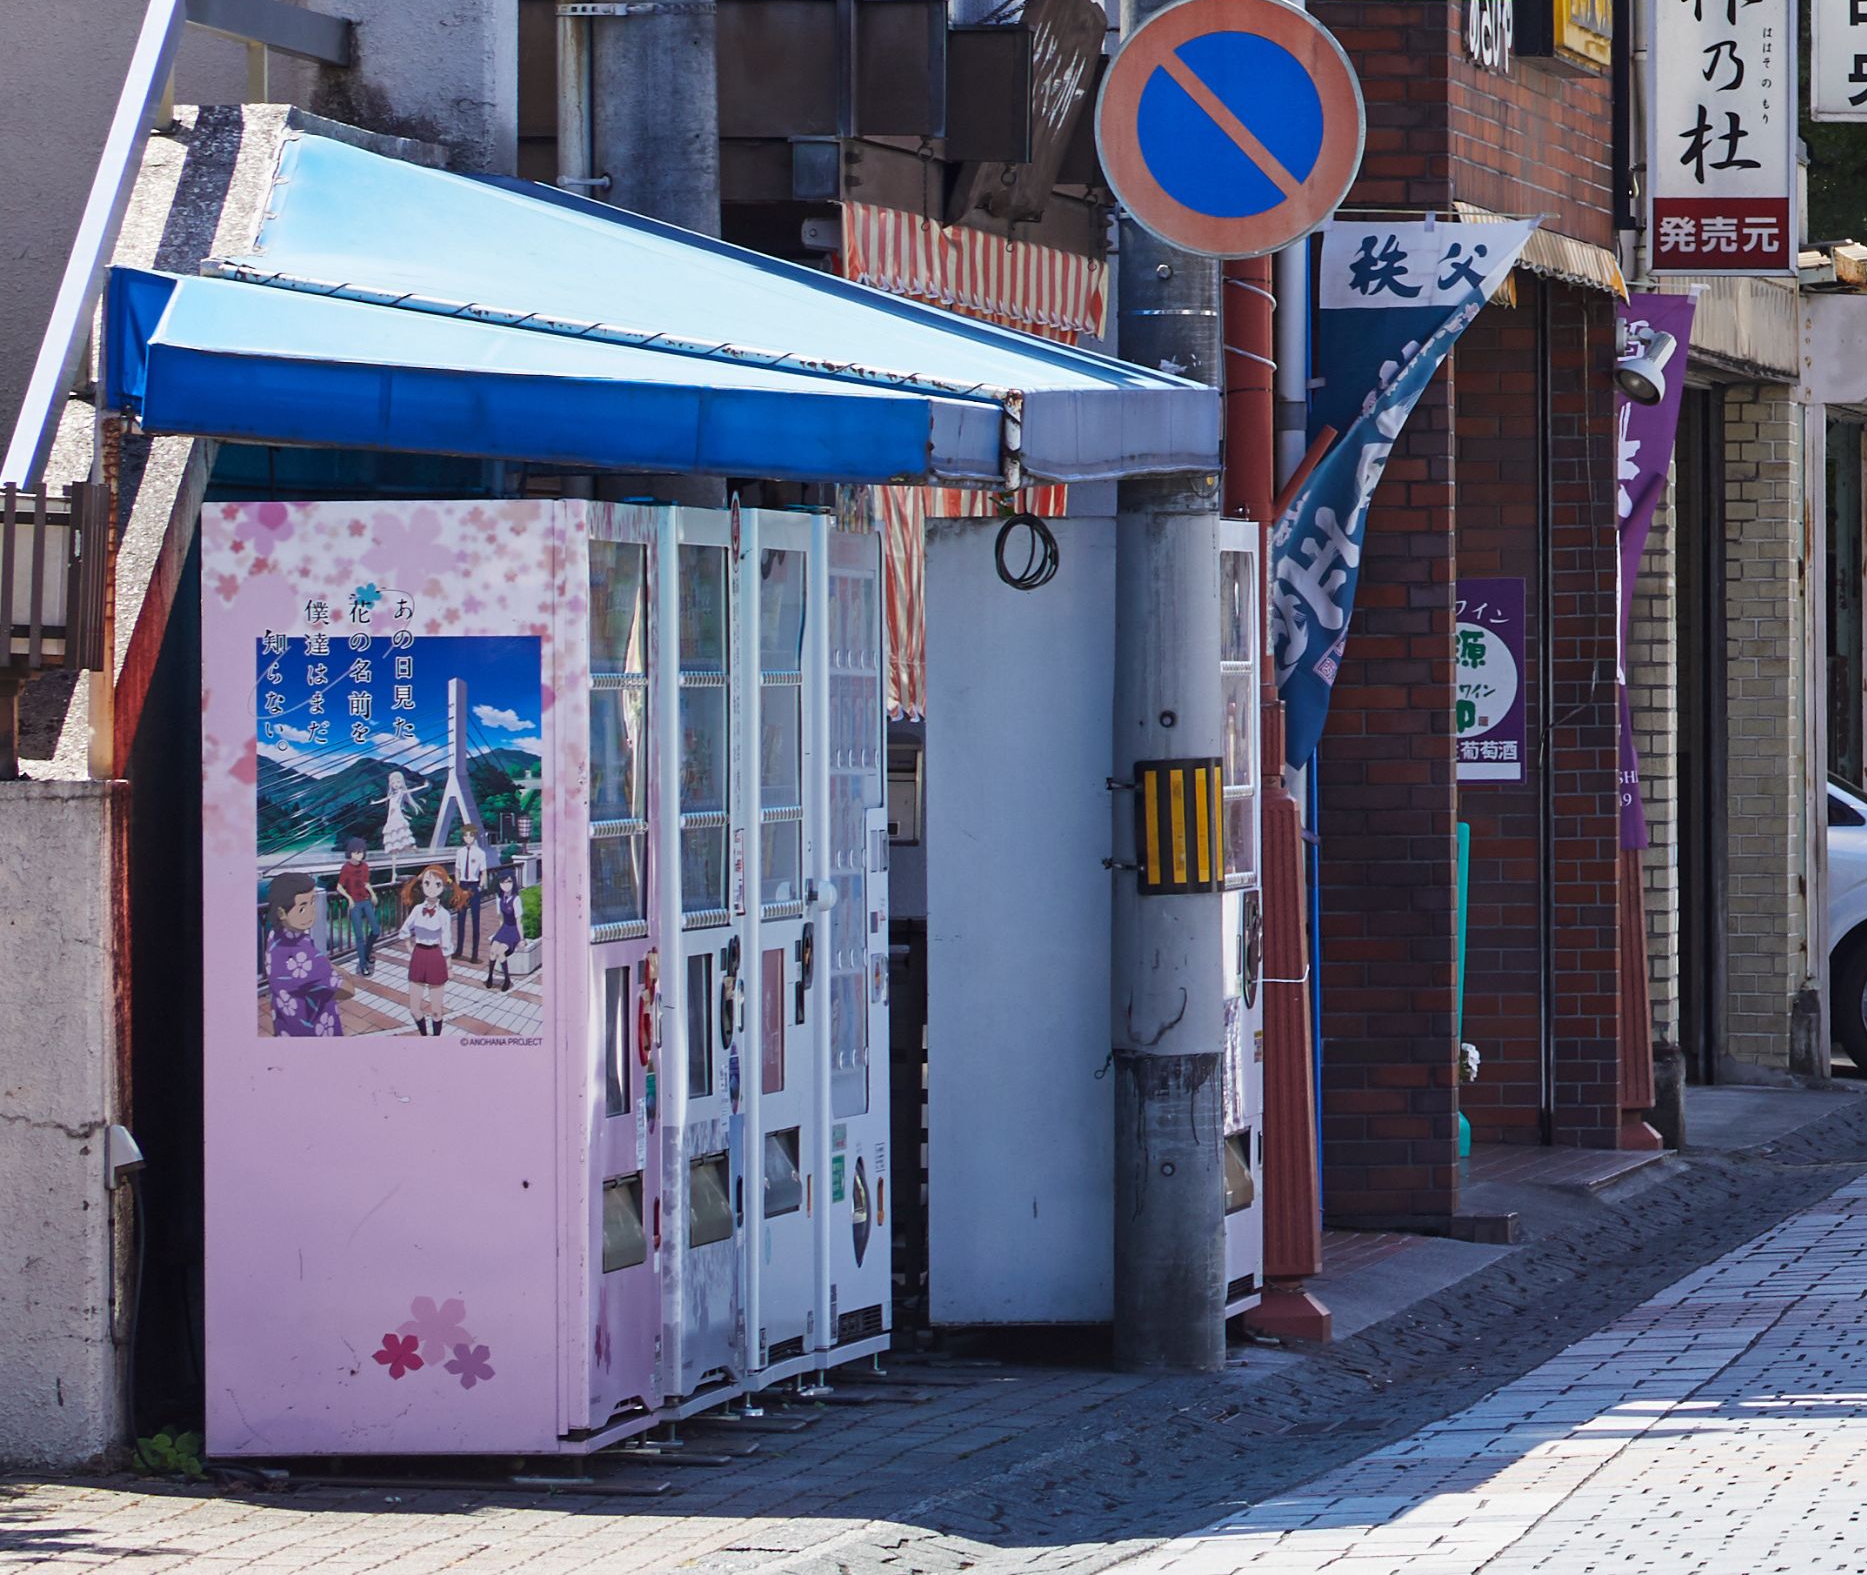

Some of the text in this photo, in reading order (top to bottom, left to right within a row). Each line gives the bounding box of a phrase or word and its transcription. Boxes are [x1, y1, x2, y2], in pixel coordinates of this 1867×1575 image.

[1348, 235, 1488, 297] 秩父
[1659, 216, 1780, 253] 発売元
[261, 628, 289, 752] 知らない。
[304, 599, 331, 745] 僕達はまだ
[349, 597, 373, 744] 花の名前を
[391, 598, 416, 740] あの日見た
[1459, 684, 1496, 698] ワイン
[1458, 740, 1518, 761] 葡萄酒
